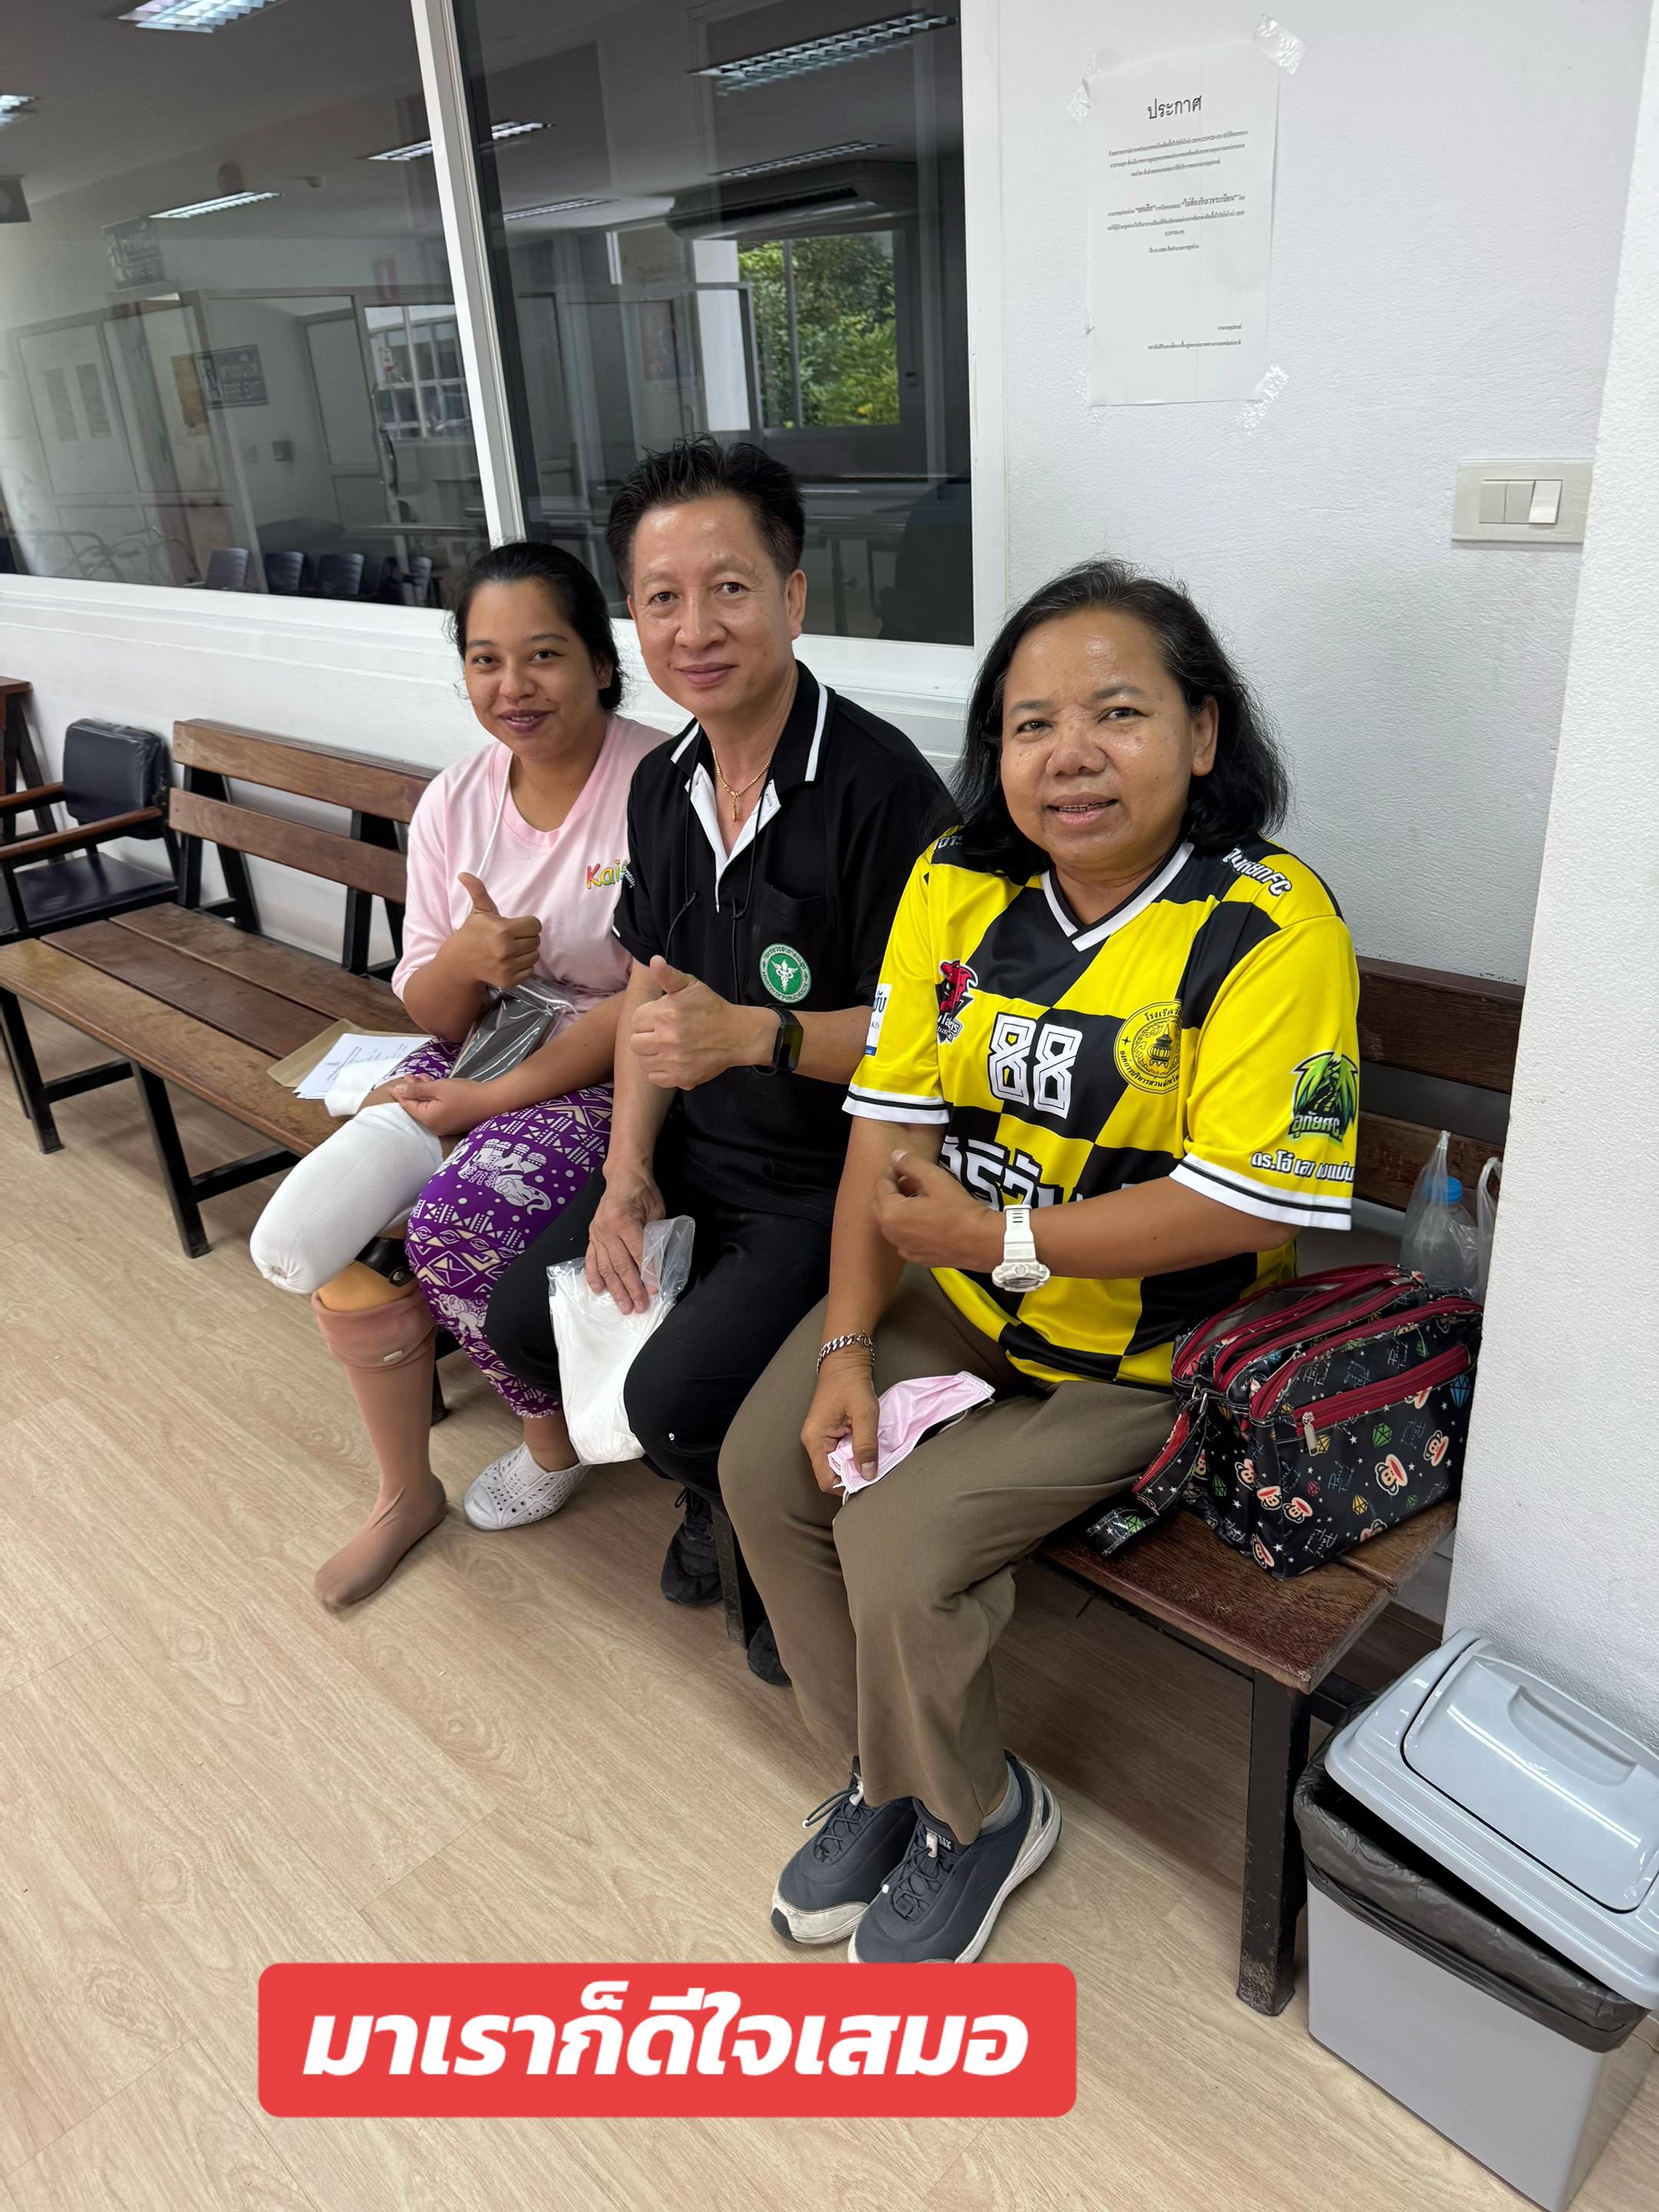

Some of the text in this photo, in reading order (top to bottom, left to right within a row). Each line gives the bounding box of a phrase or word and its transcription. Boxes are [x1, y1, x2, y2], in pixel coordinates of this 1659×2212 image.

[1148, 96, 1201, 119] ประกาศ
[987, 1012, 1084, 1121] 88
